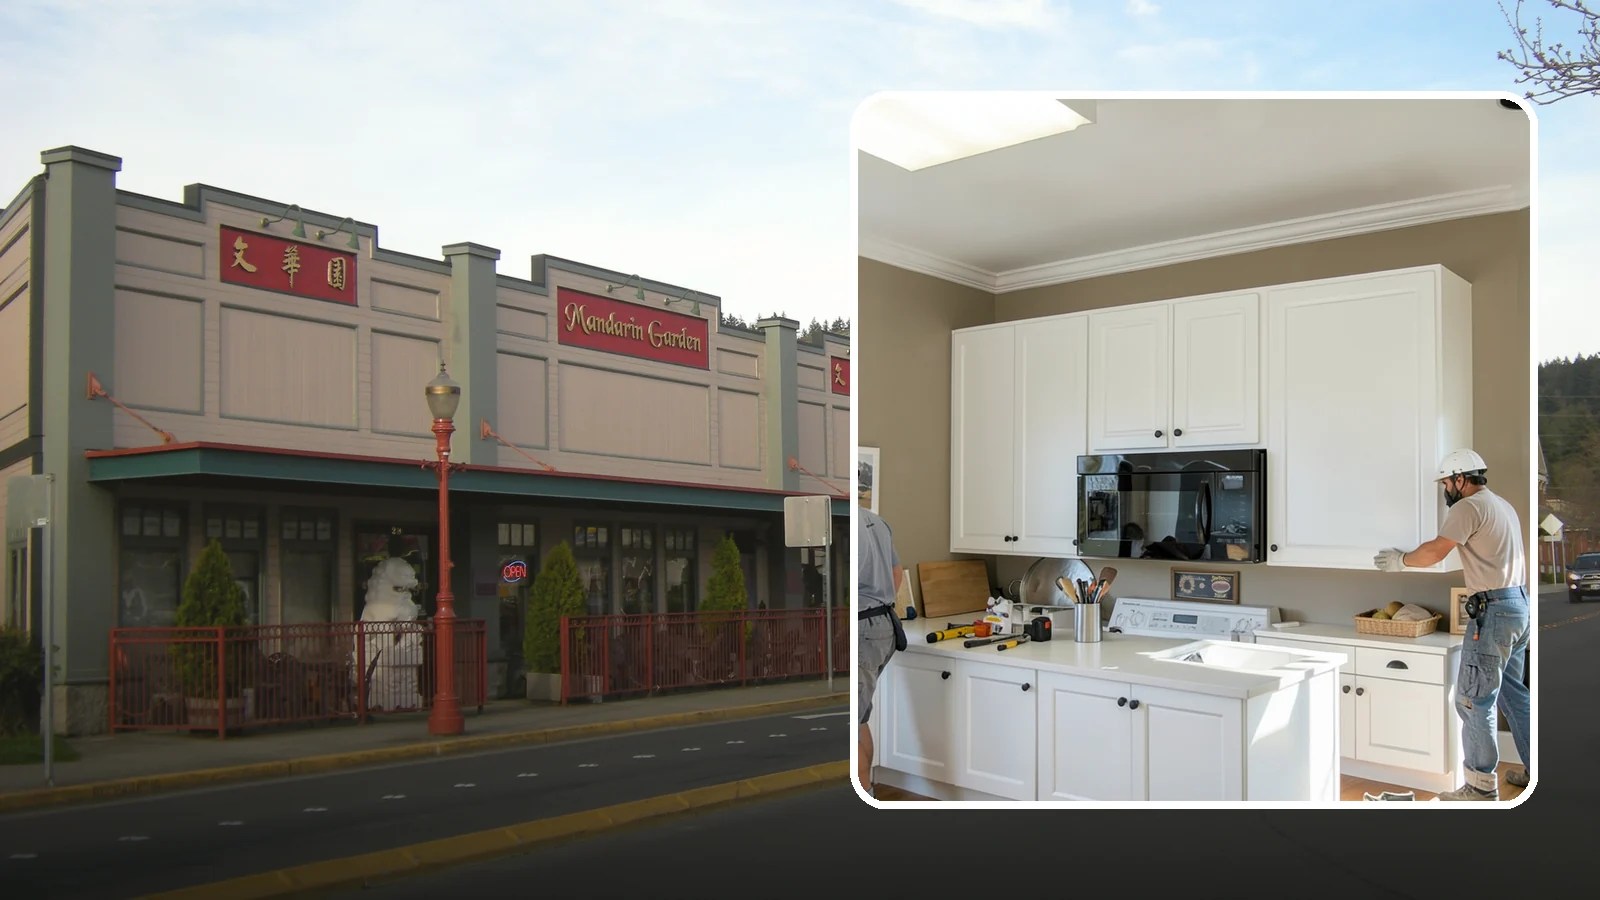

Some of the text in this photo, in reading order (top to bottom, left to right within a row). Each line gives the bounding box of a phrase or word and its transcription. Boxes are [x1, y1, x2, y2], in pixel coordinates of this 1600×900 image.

[231, 235, 346, 291] 文華園
[564, 302, 701, 352] Mandarin Garden
[503, 565, 526, 578] OPEN
